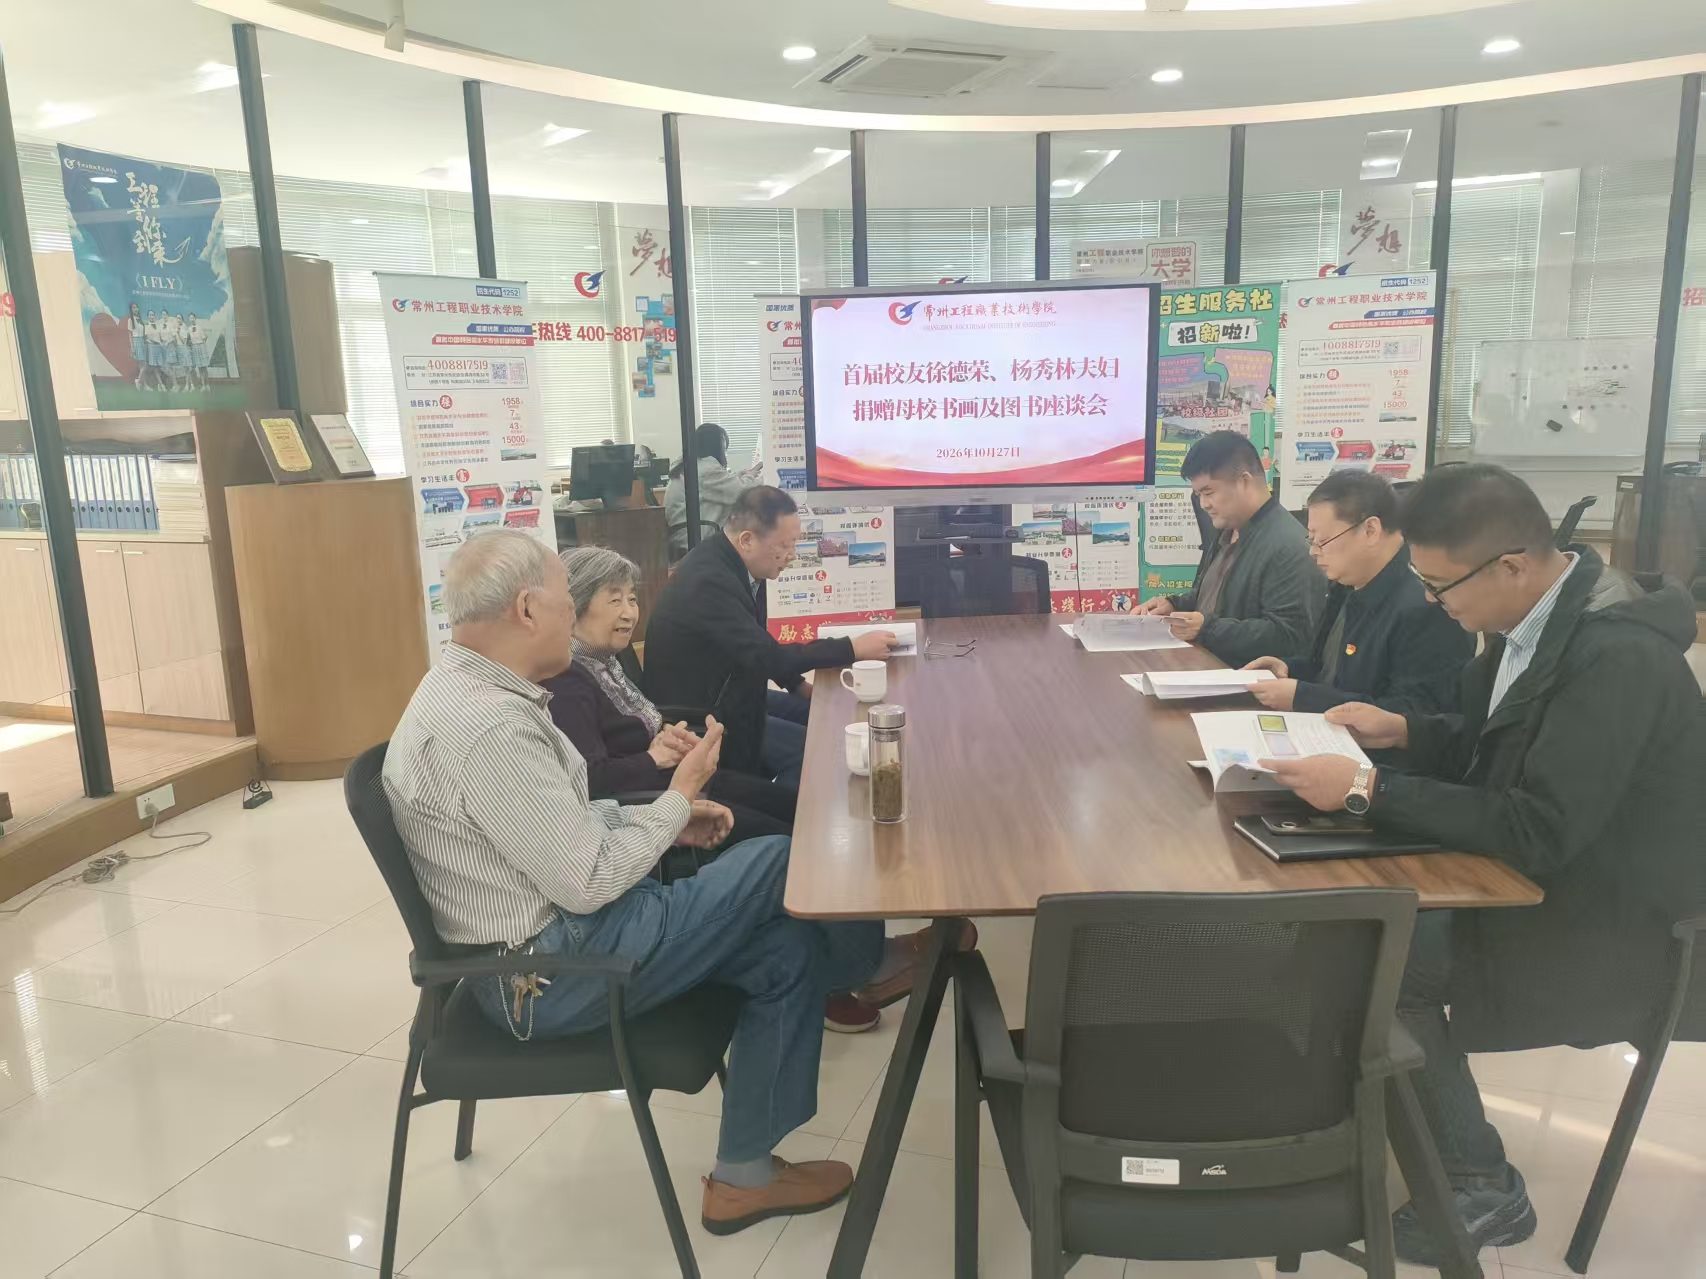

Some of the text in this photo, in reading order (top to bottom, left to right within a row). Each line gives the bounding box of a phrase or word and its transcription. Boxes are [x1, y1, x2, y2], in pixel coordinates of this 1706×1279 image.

[1151, 258, 1191, 278] 大学
[502, 289, 519, 297] 1252
[411, 300, 524, 317] 常州工程职业技术学院
[428, 360, 488, 370] 4008817519
[842, 356, 1120, 386] 首届校友徐德荣、杨秀林夫妇
[853, 394, 1109, 421] 捐赠母校书画及图书座谈会
[936, 446, 1020, 459] 2026年10月27日
